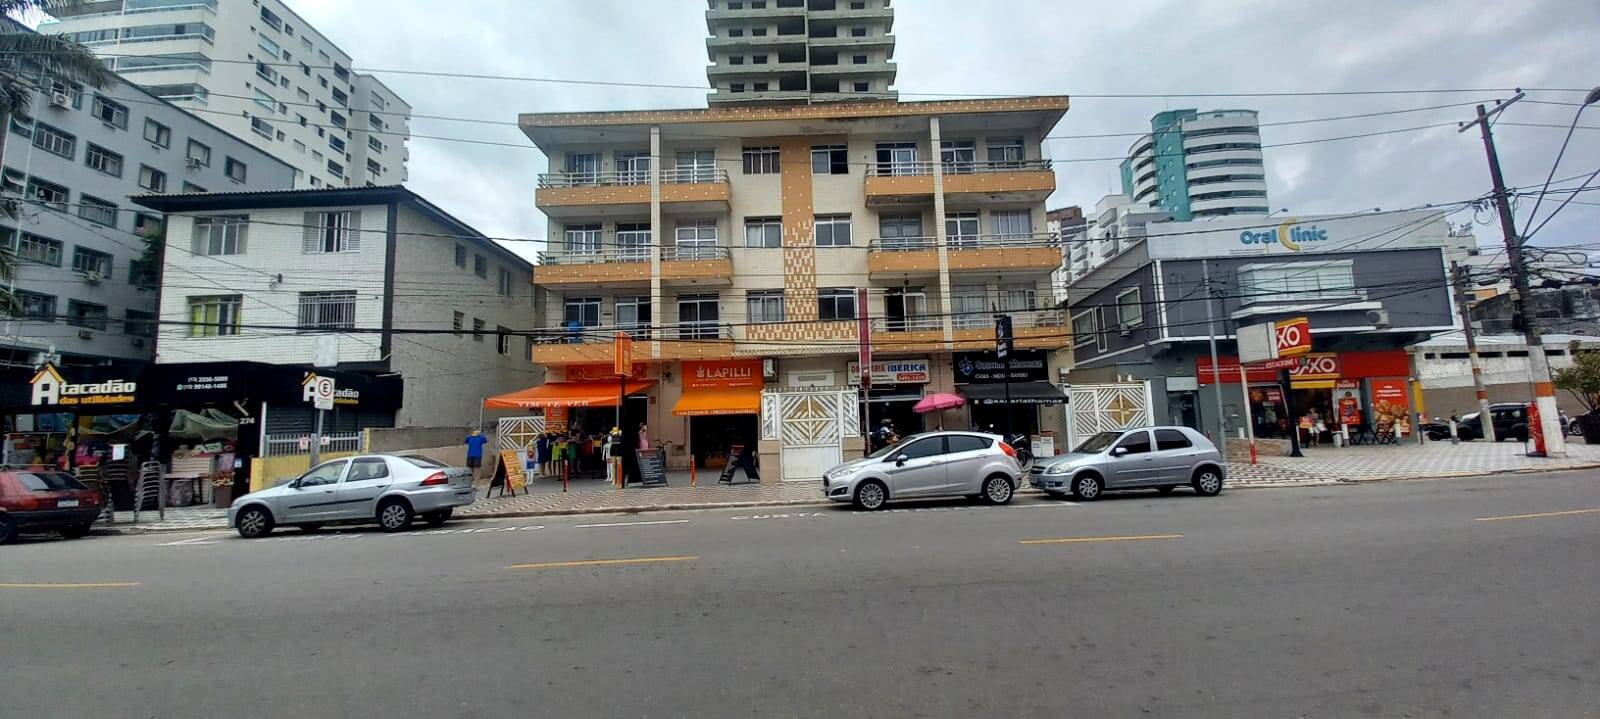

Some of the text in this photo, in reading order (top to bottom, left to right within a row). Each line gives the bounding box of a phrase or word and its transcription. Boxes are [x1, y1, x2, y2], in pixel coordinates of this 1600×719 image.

[706, 367, 751, 378] LAPILLI
[851, 364, 886, 374] DRARIA
[29, 362, 136, 405] Atacadão
[323, 383, 329, 393] E
